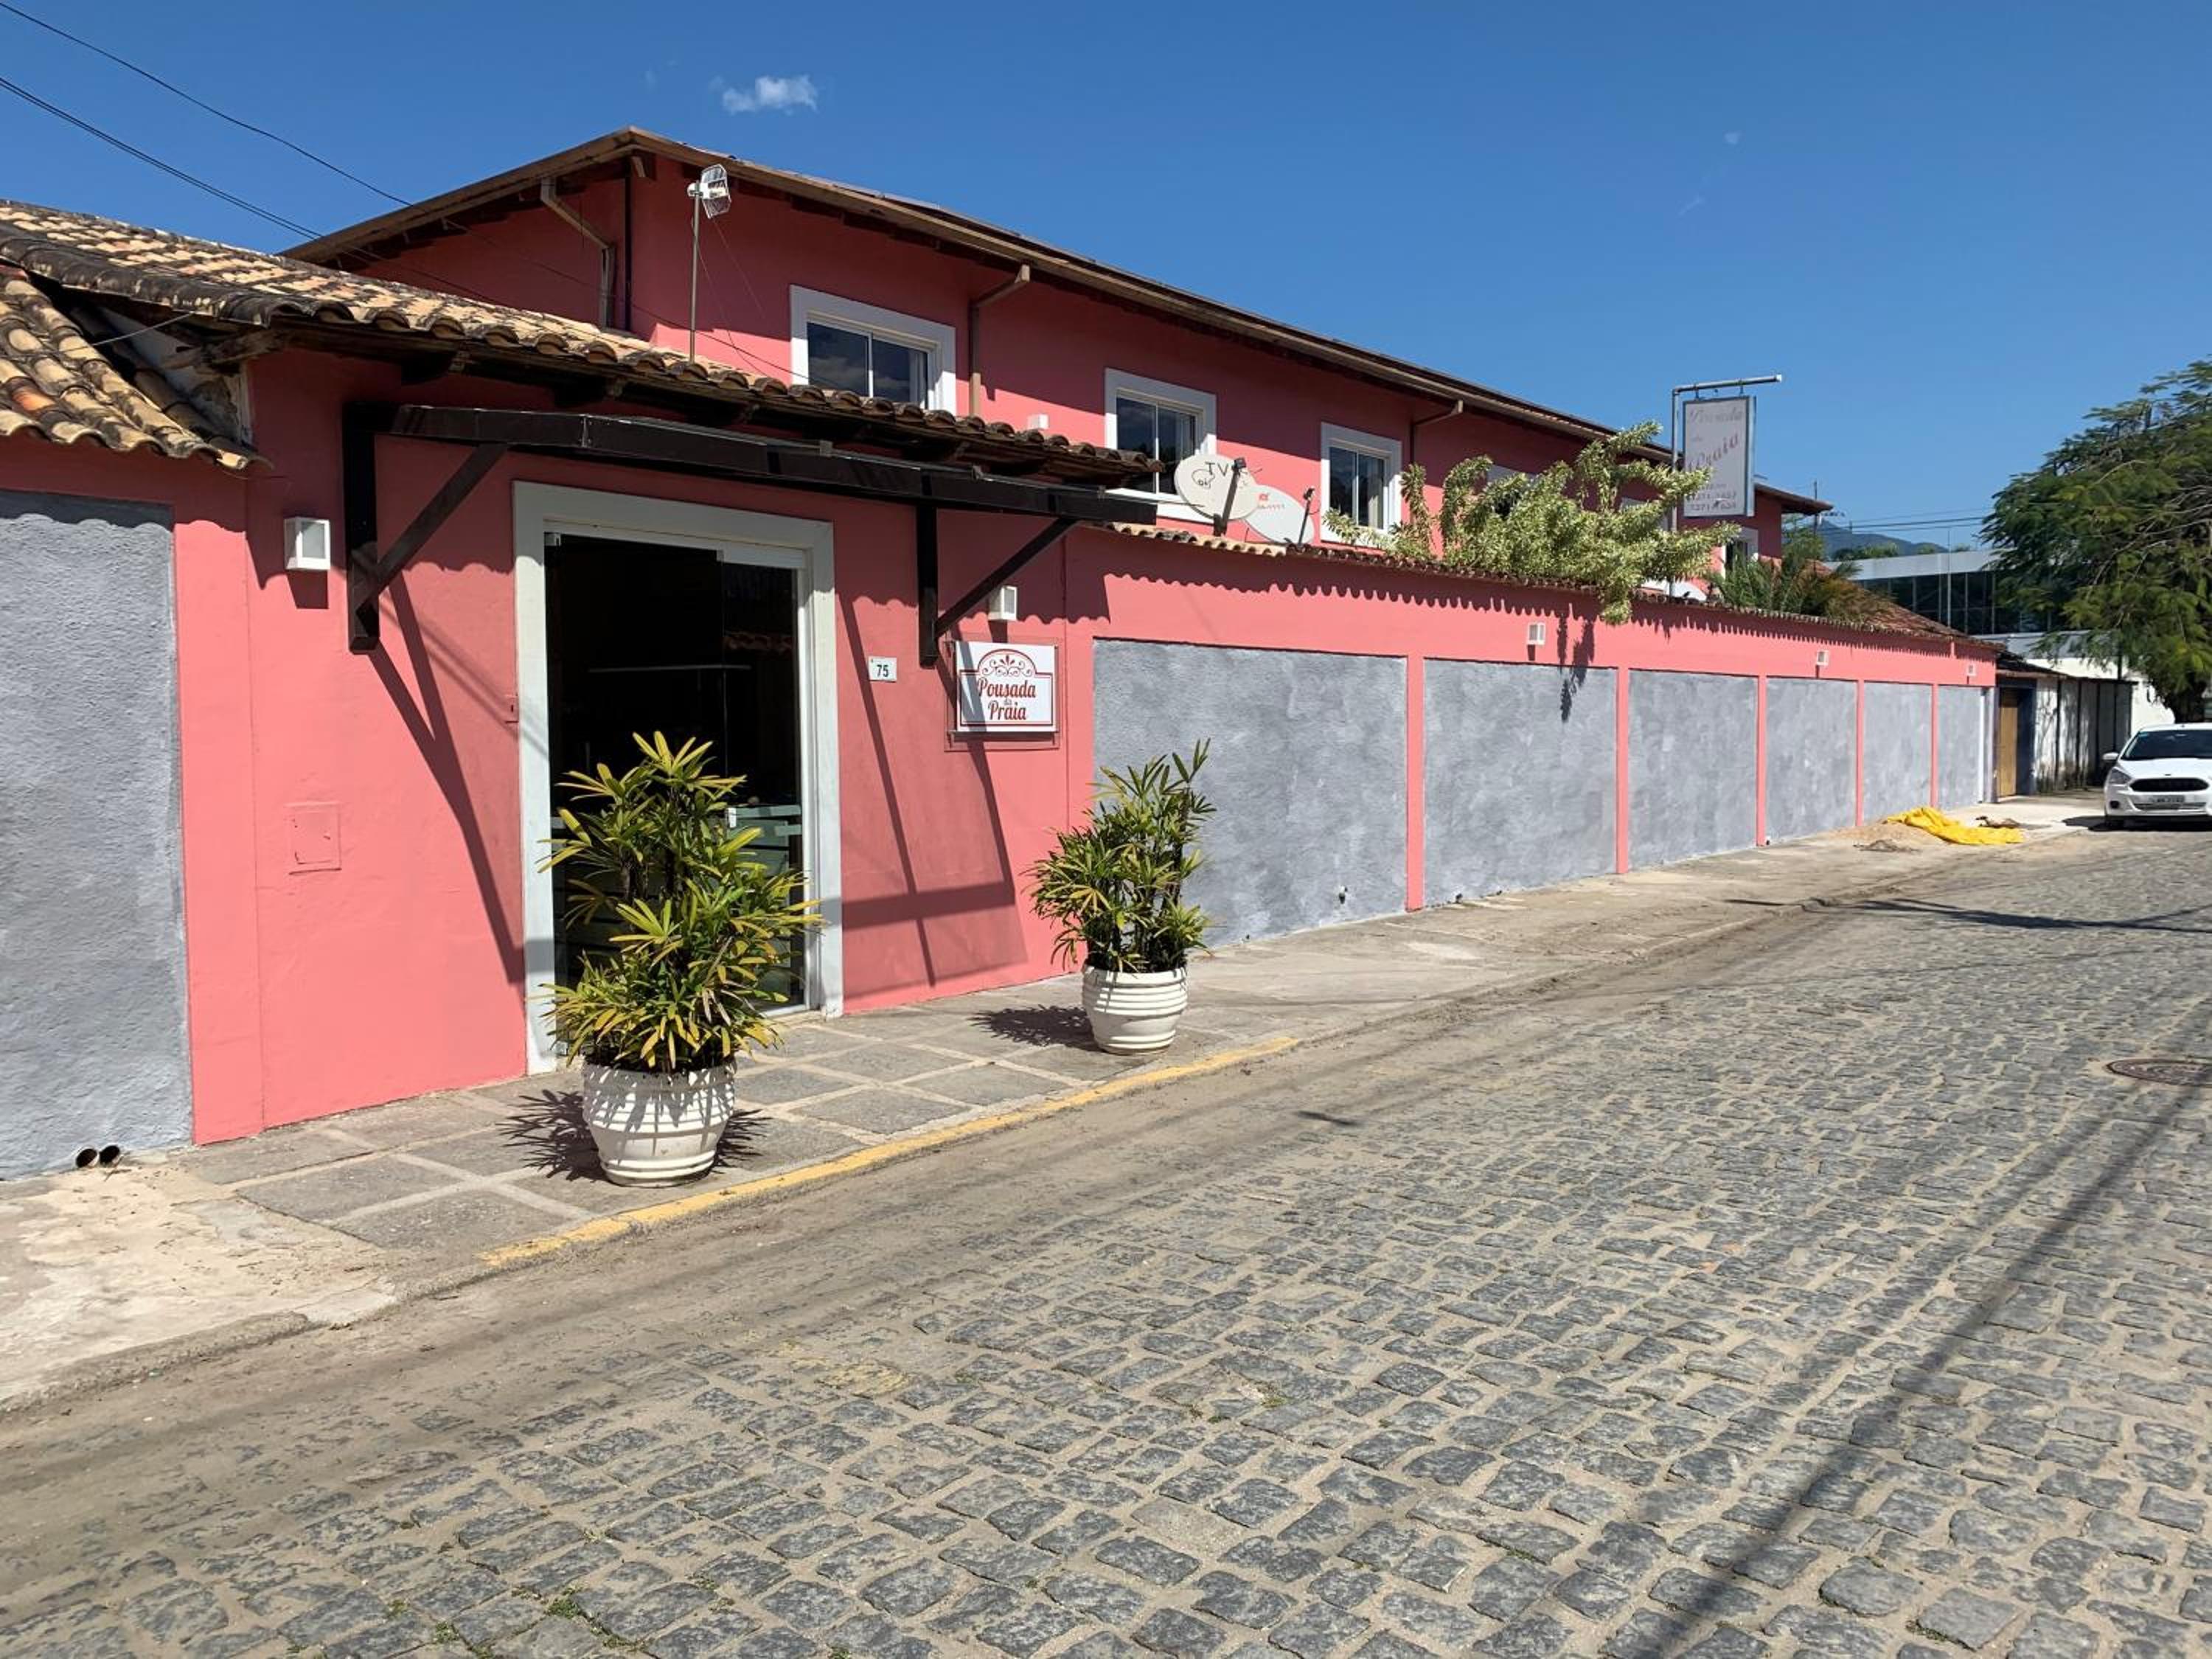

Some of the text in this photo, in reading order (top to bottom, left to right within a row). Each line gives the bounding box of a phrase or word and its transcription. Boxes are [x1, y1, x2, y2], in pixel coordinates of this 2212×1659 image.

[1205, 461, 1229, 476] TV
[877, 664, 888, 677] 75
[978, 677, 1035, 698] Pousada
[988, 700, 1026, 720] Praia
